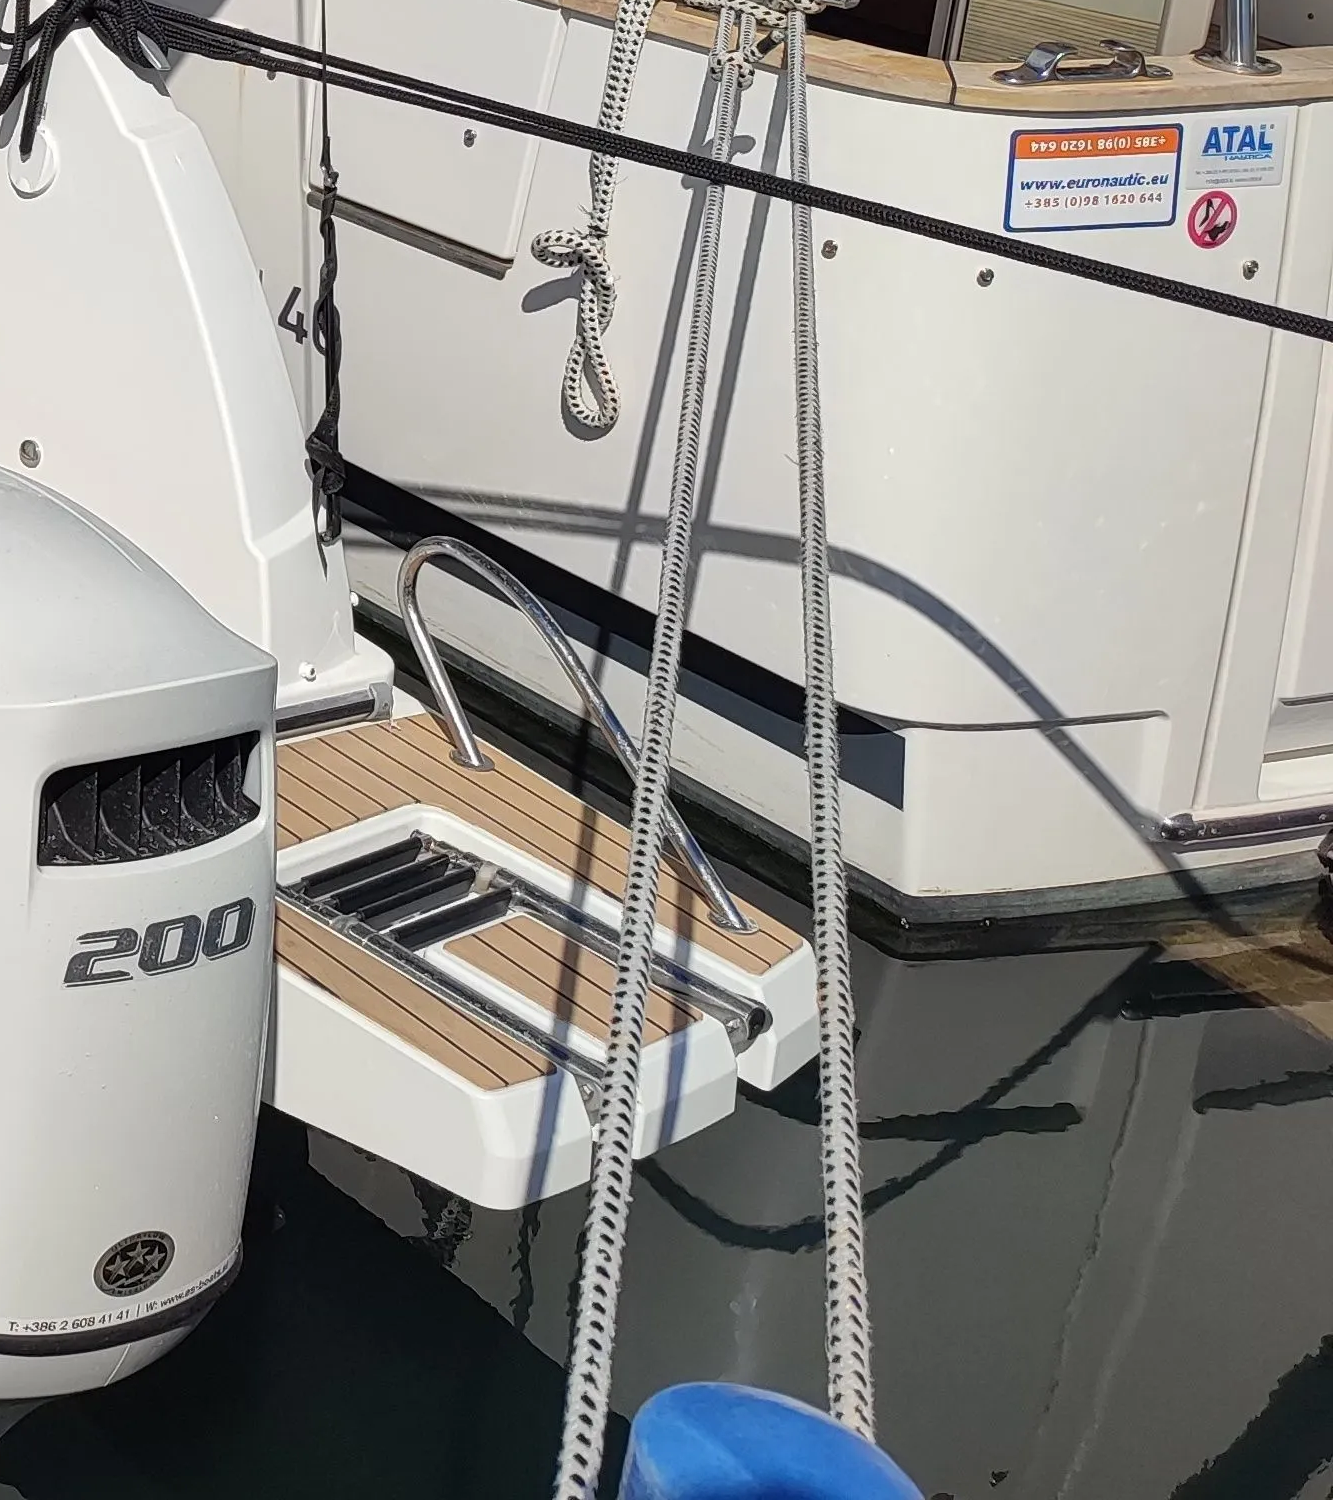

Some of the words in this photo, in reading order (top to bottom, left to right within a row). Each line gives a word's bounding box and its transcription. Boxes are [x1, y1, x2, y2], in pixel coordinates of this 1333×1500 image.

[1030, 140, 1057, 153] 644
[1060, 139, 1093, 152] 1620
[1201, 124, 1274, 154] ATAL
[1019, 173, 1170, 191] www.euronautic.eu
[1024, 197, 1060, 209] +385
[1064, 195, 1100, 209] (0)98
[1104, 193, 1135, 206] 1620
[1139, 192, 1163, 203] 644
[62, 896, 258, 989] 200
[23, 1320, 57, 1333] +386
[60, 1320, 69, 1331] 2
[71, 1316, 96, 1330] 608
[97, 1313, 113, 1325] 41
[116, 1308, 130, 1321] 41
